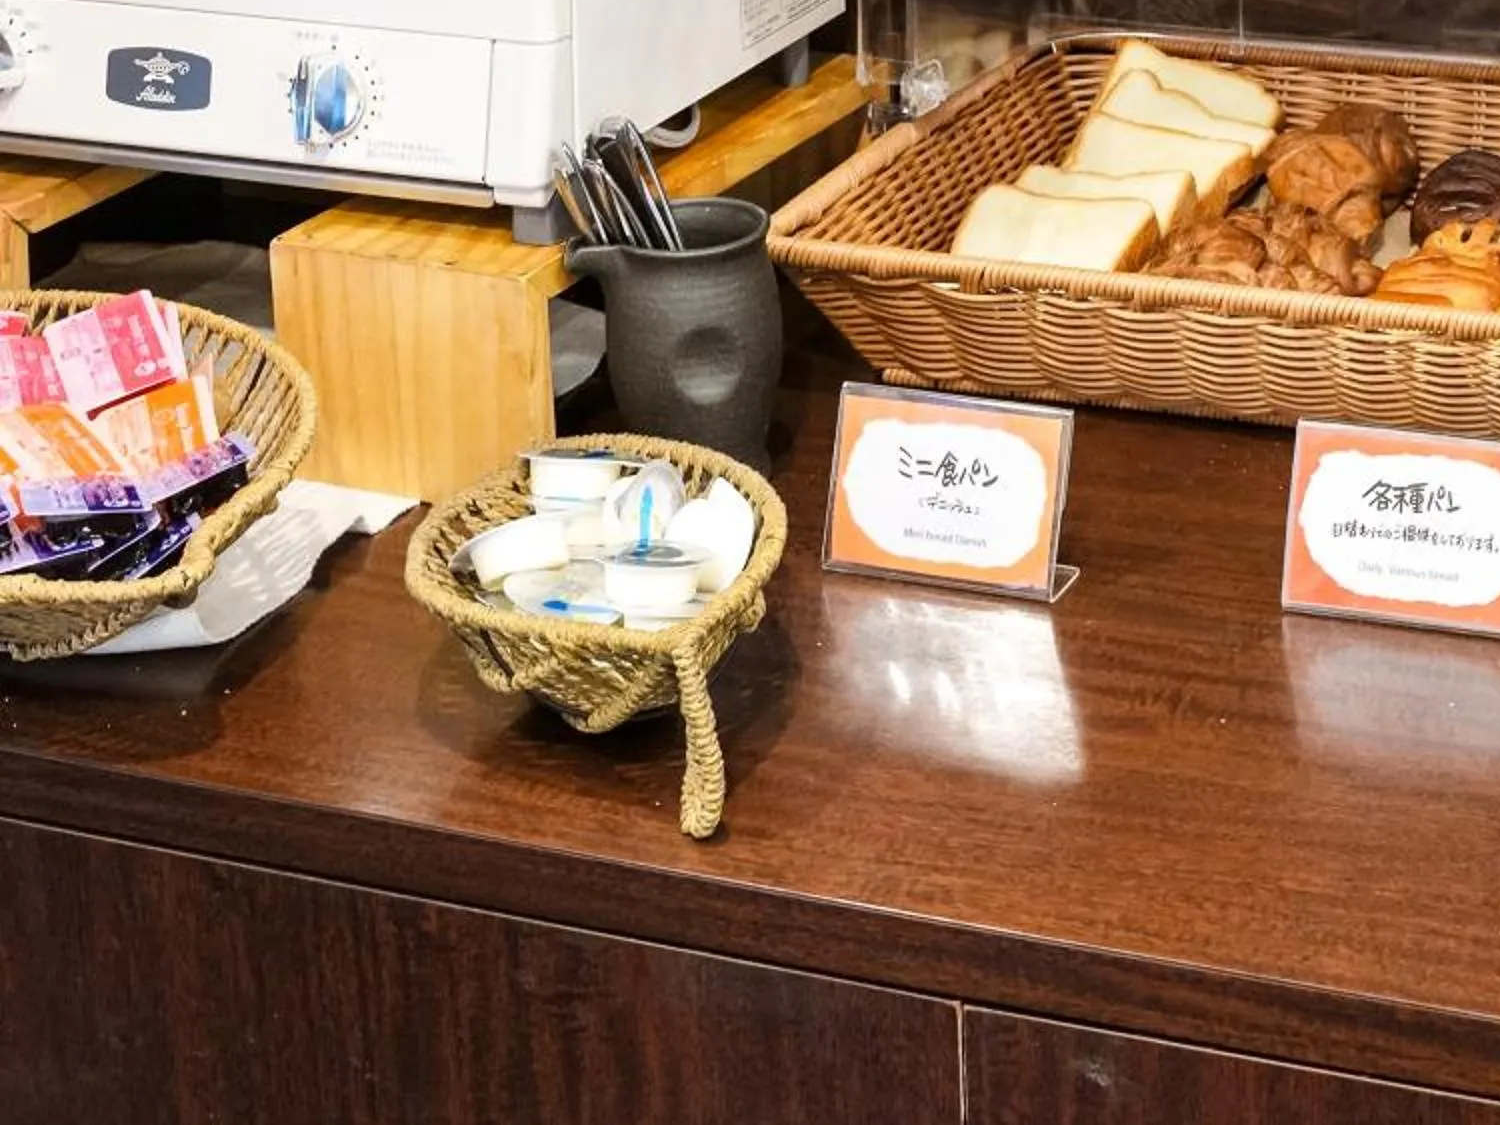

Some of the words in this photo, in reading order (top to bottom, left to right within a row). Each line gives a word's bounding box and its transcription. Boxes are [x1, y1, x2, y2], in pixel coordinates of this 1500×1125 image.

[898, 446, 999, 488] ミニ食パン
[1361, 479, 1462, 514] 各種パン
